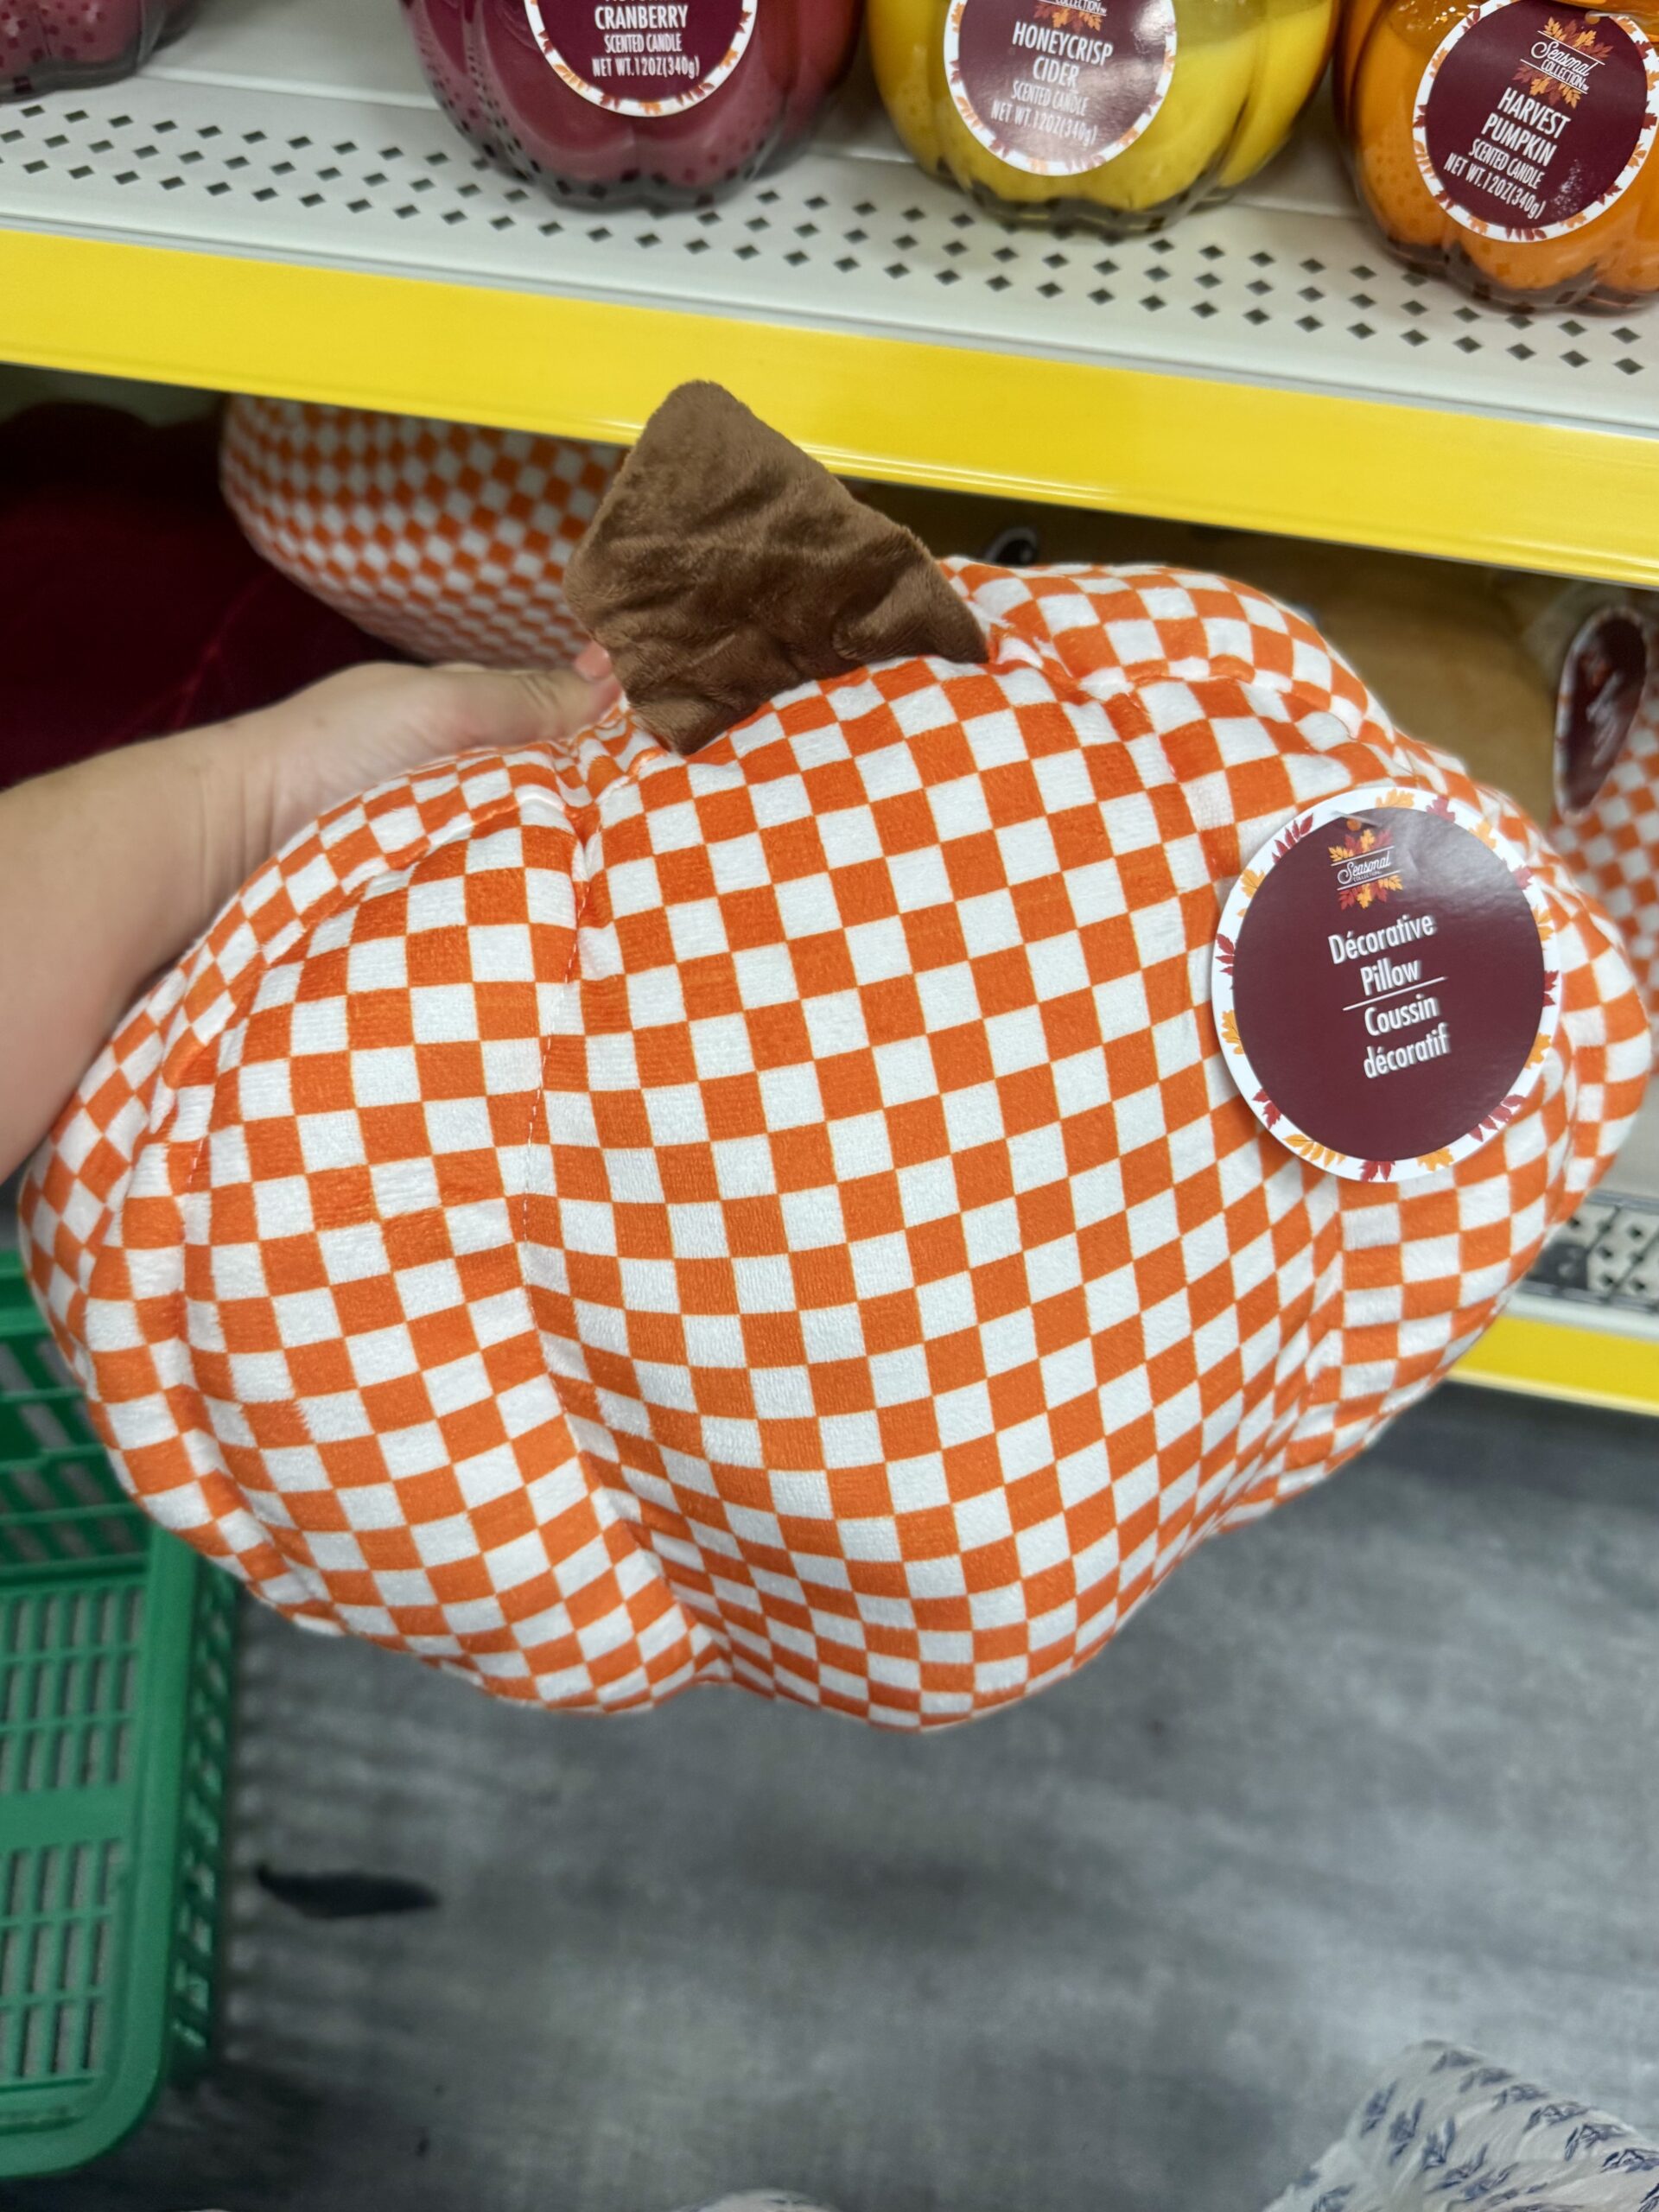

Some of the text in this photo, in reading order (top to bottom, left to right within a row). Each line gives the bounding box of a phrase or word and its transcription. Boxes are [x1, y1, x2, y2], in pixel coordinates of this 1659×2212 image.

[594, 5, 689, 29] CRANBERRY
[604, 33, 682, 54] SCENTED CANDLE
[1012, 21, 1114, 67] HONEYCRISP
[1531, 41, 1599, 76] Seasonal
[592, 57, 613, 77] NET
[1033, 56, 1079, 87] CIDER
[990, 99, 1013, 123] NET
[1011, 80, 1090, 117] SCENTED CANDLE
[1497, 87, 1571, 139] HARVEST
[1481, 112, 1557, 167] PUMPKIN
[1444, 153, 1469, 176] NET
[1469, 138, 1545, 190] SCENTED CANDLE
[1338, 850, 1391, 885] Seasonal
[1328, 914, 1437, 965] Décorative
[1360, 959, 1421, 996] Pillow
[1364, 994, 1439, 1037] Coussin
[1363, 1022, 1450, 1079] décoratif
